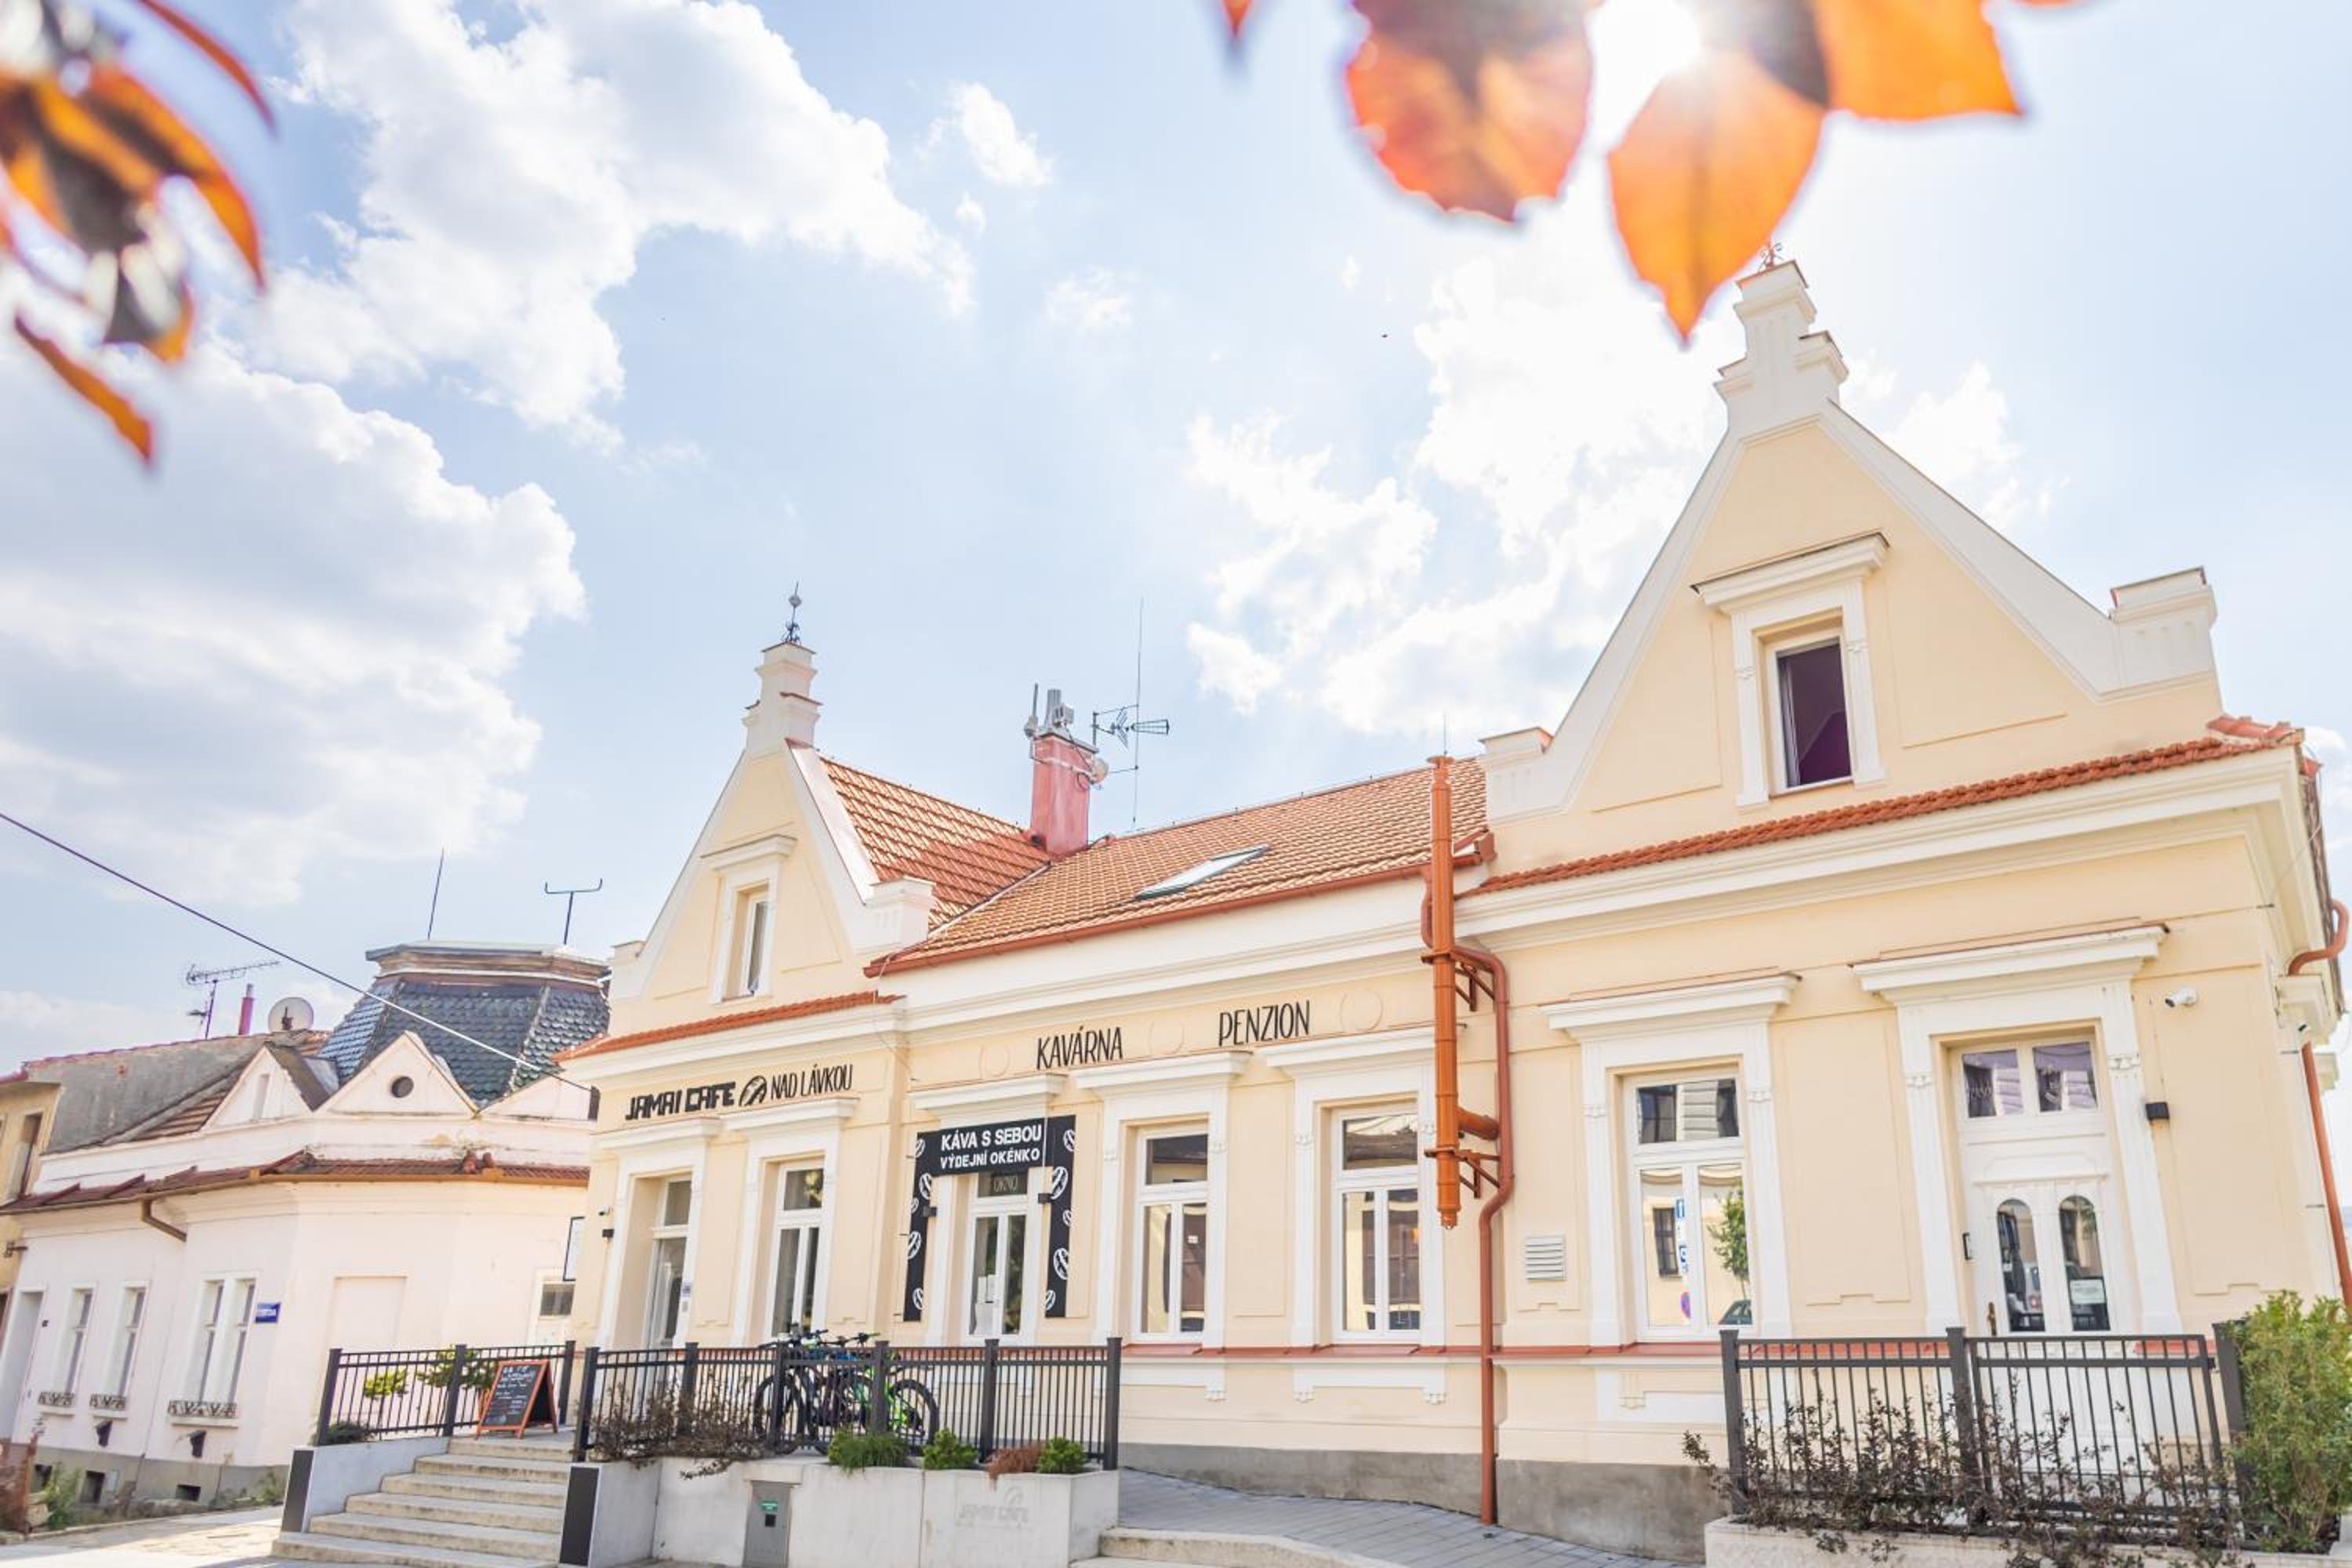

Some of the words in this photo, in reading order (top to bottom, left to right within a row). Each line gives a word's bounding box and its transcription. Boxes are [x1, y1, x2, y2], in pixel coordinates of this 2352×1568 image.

[1218, 1000, 1310, 1047] PENZION
[1036, 1026, 1123, 1069] KAVÁRNA
[626, 1091, 682, 1120] JAMAI
[684, 1082, 736, 1112] CAFE
[771, 1074, 797, 1100] NAD
[800, 1063, 853, 1097] LÁVKOU
[940, 1149, 987, 1170] VÝDEJNÍ
[990, 1147, 1040, 1165] OKÉNKO
[941, 1129, 978, 1152] KÁVA
[981, 1130, 992, 1147] S
[994, 1123, 1042, 1145] SEBOU
